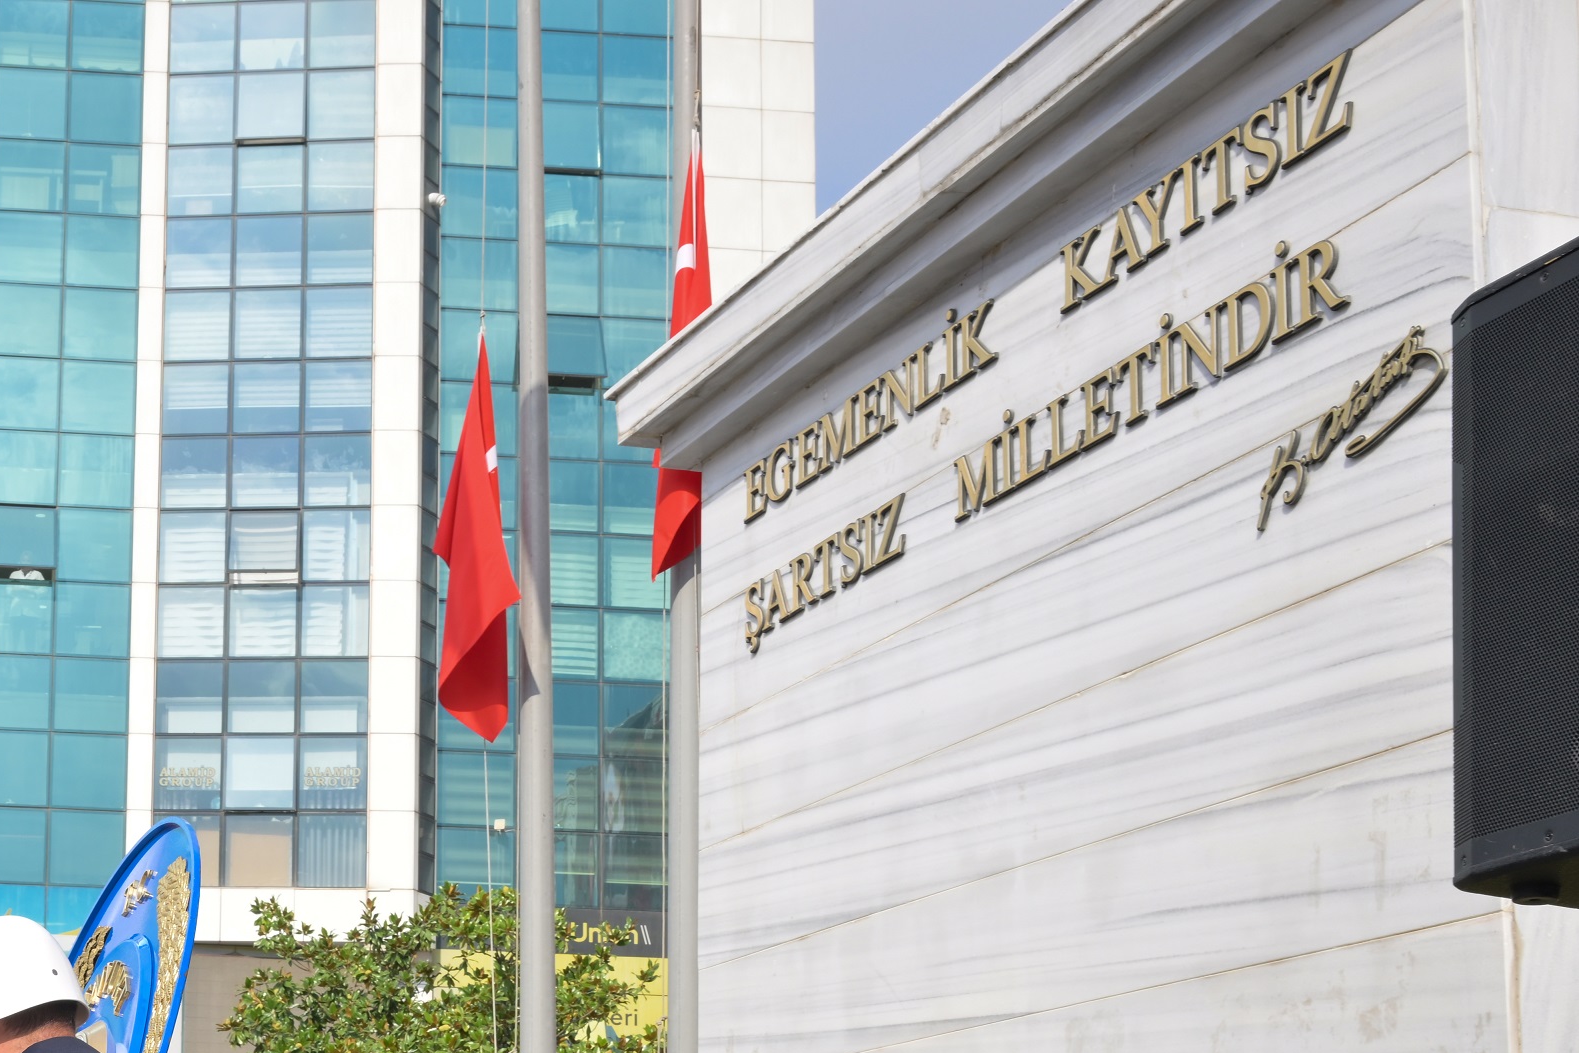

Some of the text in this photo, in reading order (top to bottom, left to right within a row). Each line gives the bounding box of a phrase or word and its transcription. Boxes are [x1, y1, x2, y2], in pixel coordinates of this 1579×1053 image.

[743, 48, 1354, 524] EGEMENLİK KAYITSIZ
[745, 239, 1350, 655] ŞARTSIZ MİLLETİNDİR
[159, 765, 216, 777] ALAMİD
[304, 765, 361, 777] ALAMİD
[158, 776, 214, 787] GROUP
[303, 776, 360, 787] GROUP
